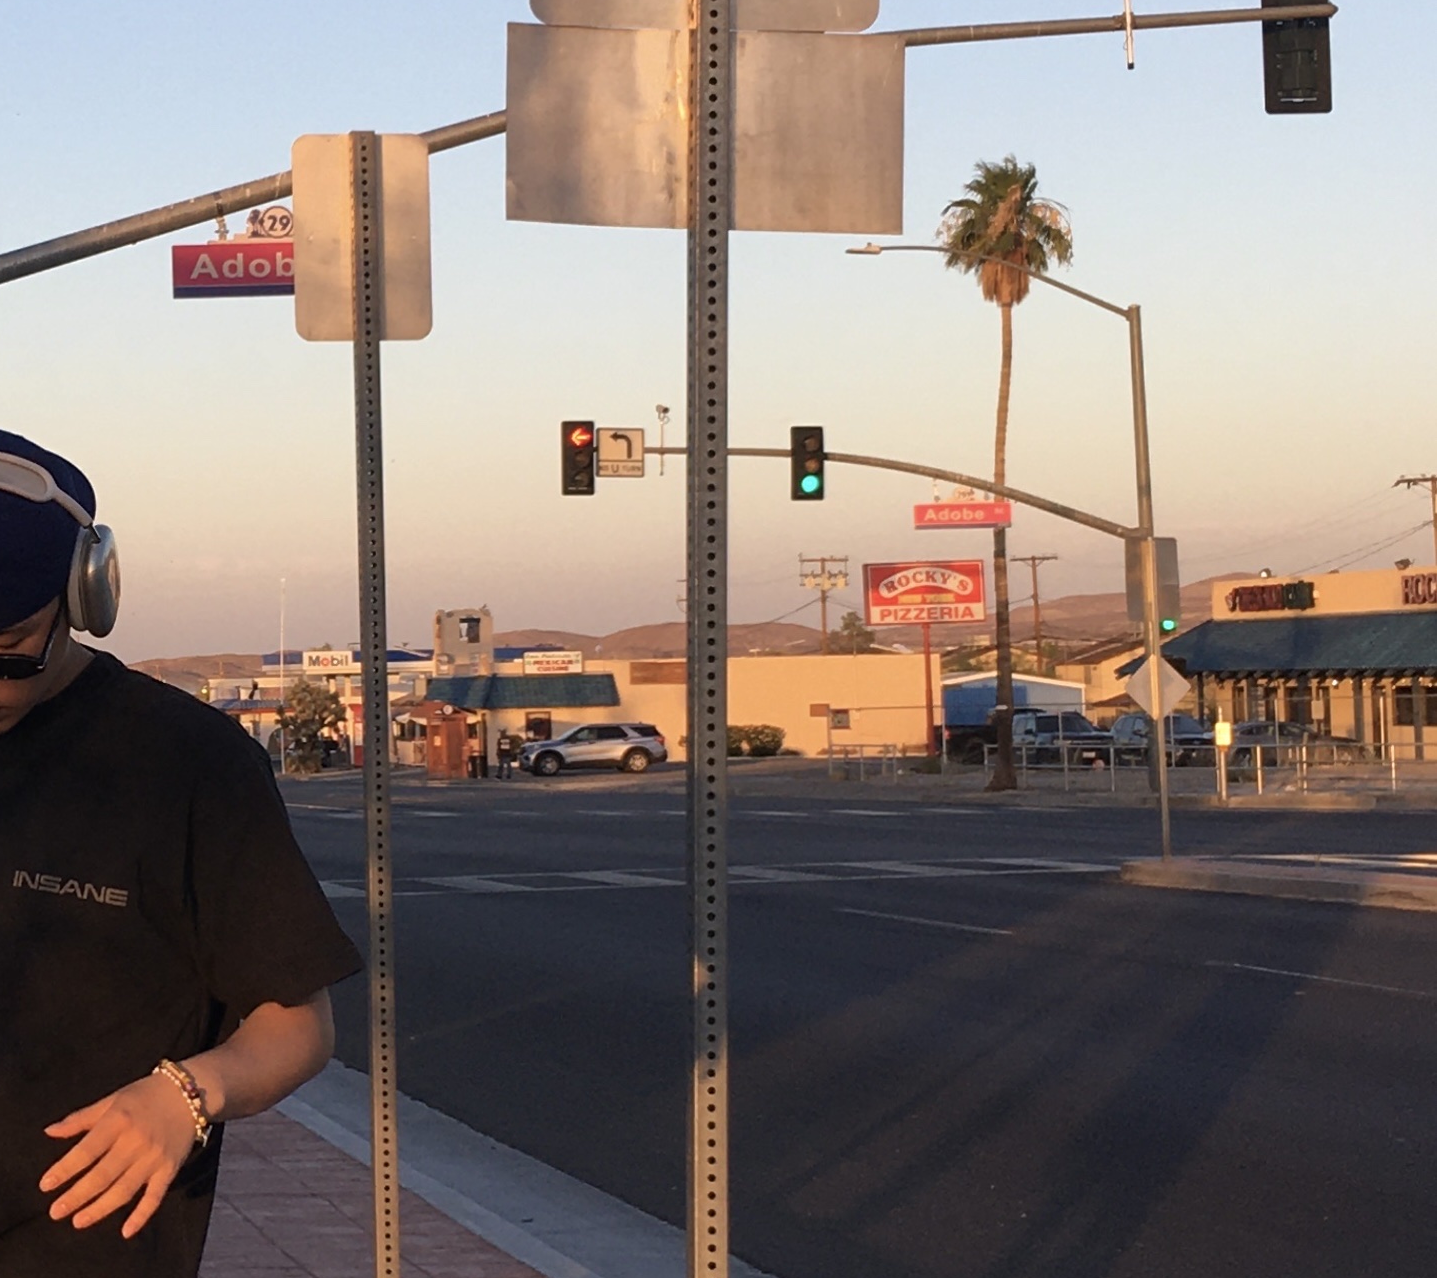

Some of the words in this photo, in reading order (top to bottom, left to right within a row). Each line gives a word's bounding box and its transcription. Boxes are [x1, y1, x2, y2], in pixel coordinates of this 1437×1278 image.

[267, 214, 291, 232] 29
[190, 252, 294, 280] Adob
[924, 508, 985, 521] Adobe
[883, 570, 969, 594] ROCKY'S
[879, 606, 975, 622] PIZZERIA
[307, 654, 349, 667] Mobil
[13, 870, 129, 907] INSANE
